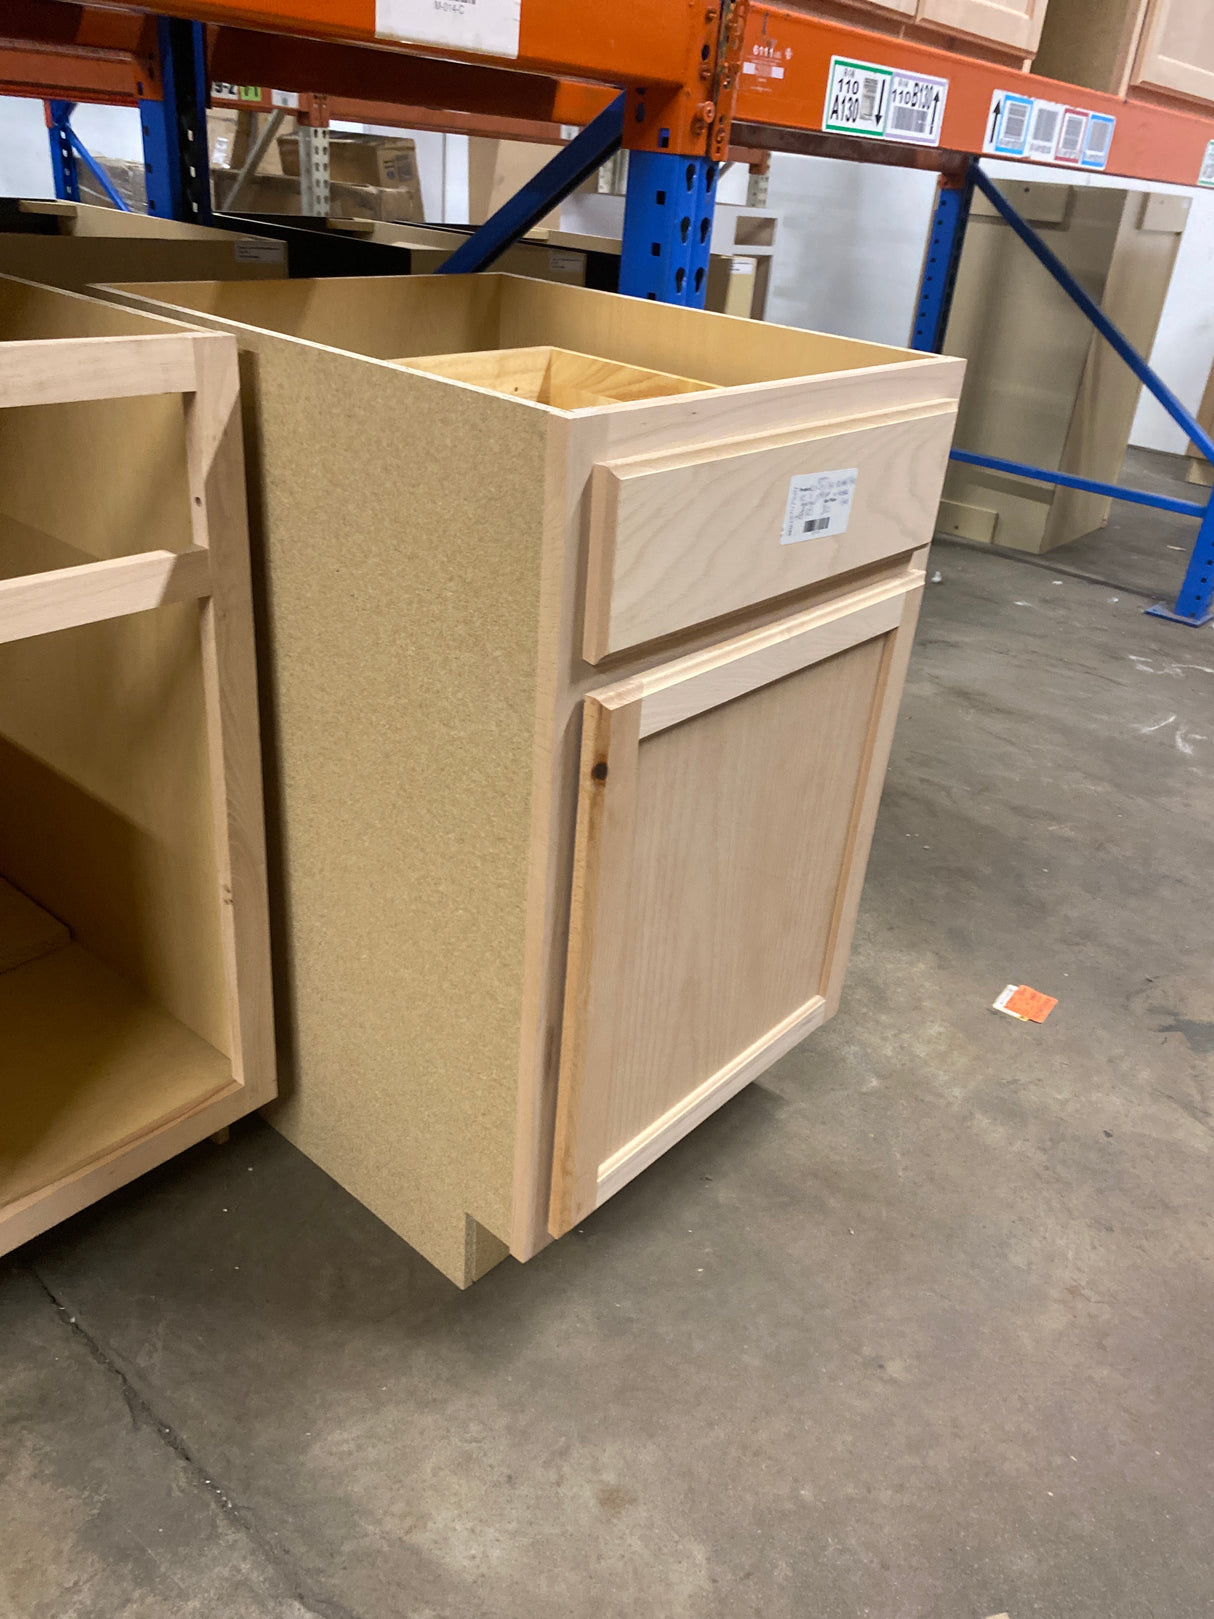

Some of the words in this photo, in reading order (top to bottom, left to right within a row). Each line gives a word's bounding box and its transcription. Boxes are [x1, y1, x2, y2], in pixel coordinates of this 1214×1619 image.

[838, 78, 859, 95] 110
[892, 89, 911, 105] 110
[911, 82, 934, 110] B130
[830, 95, 859, 123] A130
